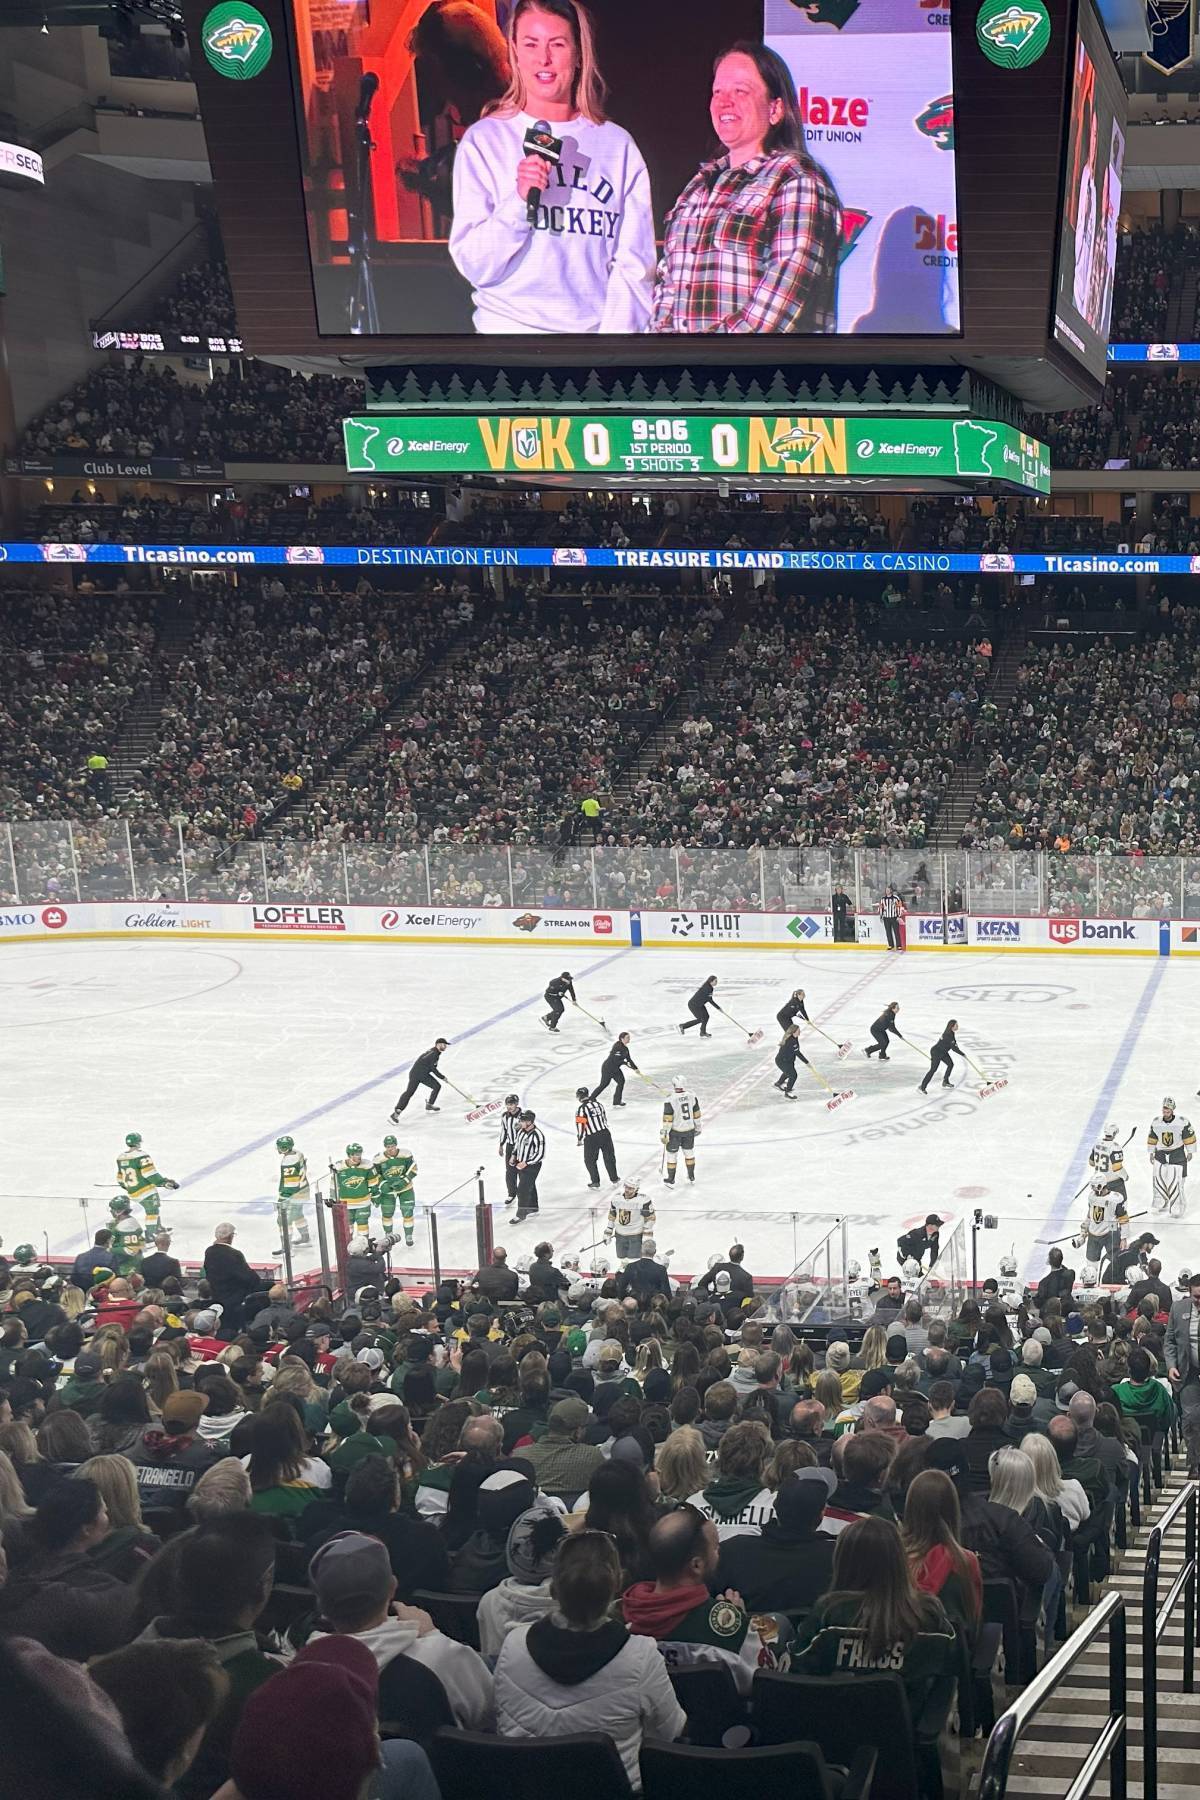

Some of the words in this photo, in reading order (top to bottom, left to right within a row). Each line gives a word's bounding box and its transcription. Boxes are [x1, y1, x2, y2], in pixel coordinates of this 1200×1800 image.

[928, 14, 951, 26] CRE
[800, 87, 868, 127] laze
[827, 130, 862, 143] UNION
[544, 163, 614, 204] ILD
[530, 205, 620, 238] OCKEY
[632, 419, 688, 441] 9:06
[408, 441, 434, 451] Xcel
[435, 441, 470, 453] Energy
[583, 423, 610, 466] 0
[630, 443, 648, 454] 1ST
[651, 443, 692, 454] PERIOD
[711, 423, 739, 467] 0
[878, 443, 905, 454] Xcel
[906, 443, 943, 457] Energy
[84, 463, 114, 474] Club
[118, 463, 152, 475] Level
[625, 459, 635, 471] 9
[641, 459, 683, 471] SHOTS
[690, 459, 700, 471] 3
[123, 547, 255, 562] TIcasino.com
[358, 550, 479, 564] DESTINATION
[485, 551, 518, 565] FUN
[615, 551, 710, 566] TREASURE
[716, 552, 784, 567] ISLAND
[790, 553, 856, 569] RESORT
[863, 555, 875, 569] &
[881, 555, 950, 570] CASINO
[1045, 557, 1159, 572] TIcasino.com
[125, 913, 179, 929] Golden
[181, 920, 212, 928] LIGHT
[253, 907, 344, 923] LOFFLER
[405, 914, 434, 926] Xcel
[437, 914, 478, 929] Energy
[700, 914, 741, 931] PILOT
[544, 919, 576, 928] STREAM
[578, 920, 590, 928] ON
[977, 921, 1020, 936] KFAN
[1052, 924, 1077, 938] us
[1083, 920, 1135, 940] bank
[681, 1103, 690, 1120] 9
[284, 1167, 295, 1176] 27
[136, 1466, 194, 1487] ETRANGELO
